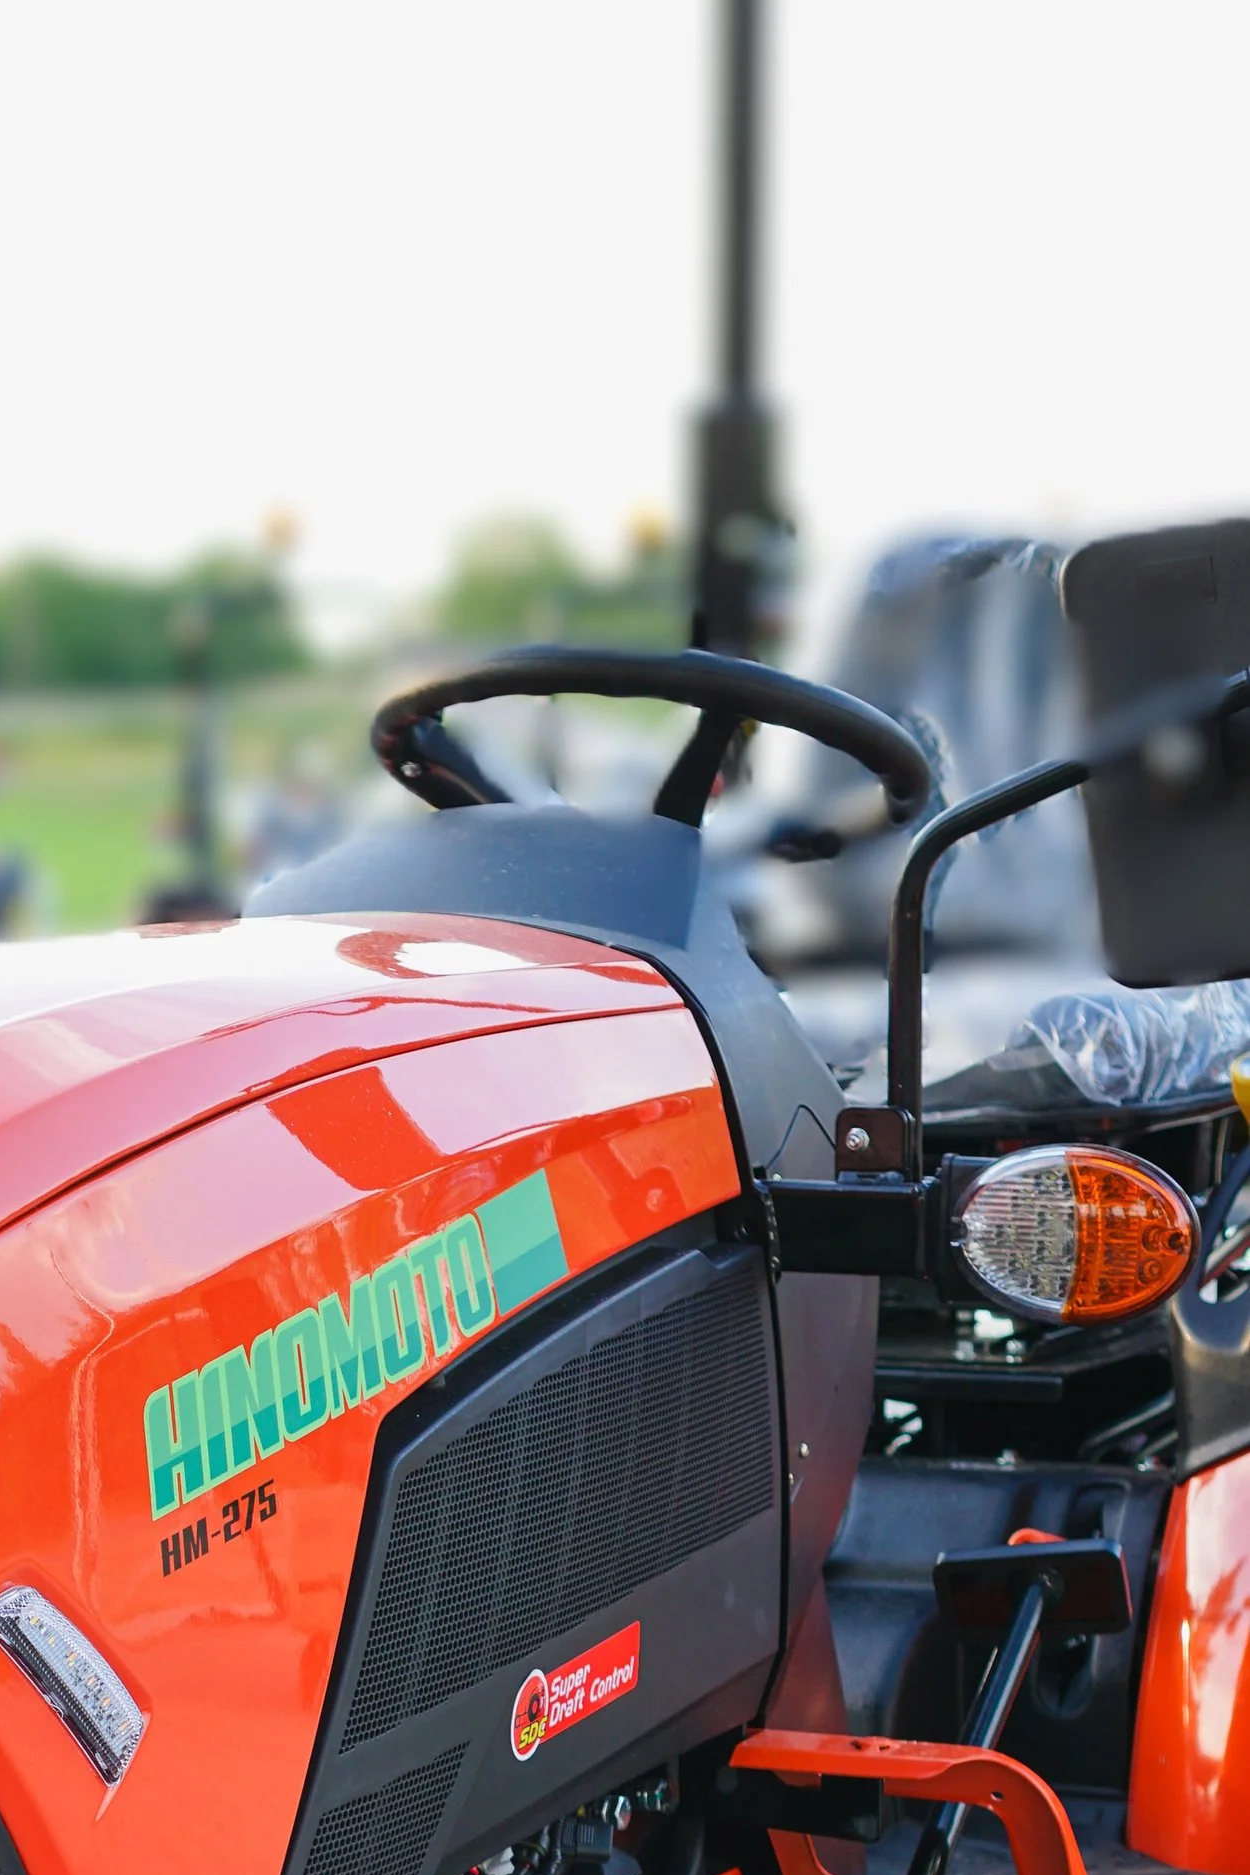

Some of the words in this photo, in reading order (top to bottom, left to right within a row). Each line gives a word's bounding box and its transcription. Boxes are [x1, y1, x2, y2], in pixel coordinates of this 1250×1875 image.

[144, 1211, 496, 1521] HINOMOTO
[160, 1478, 277, 1578] HM-275
[549, 1687, 585, 1727] Draft
[589, 1655, 635, 1703] Control
[550, 1664, 591, 1702] Super
[517, 1715, 549, 1749] SDC
